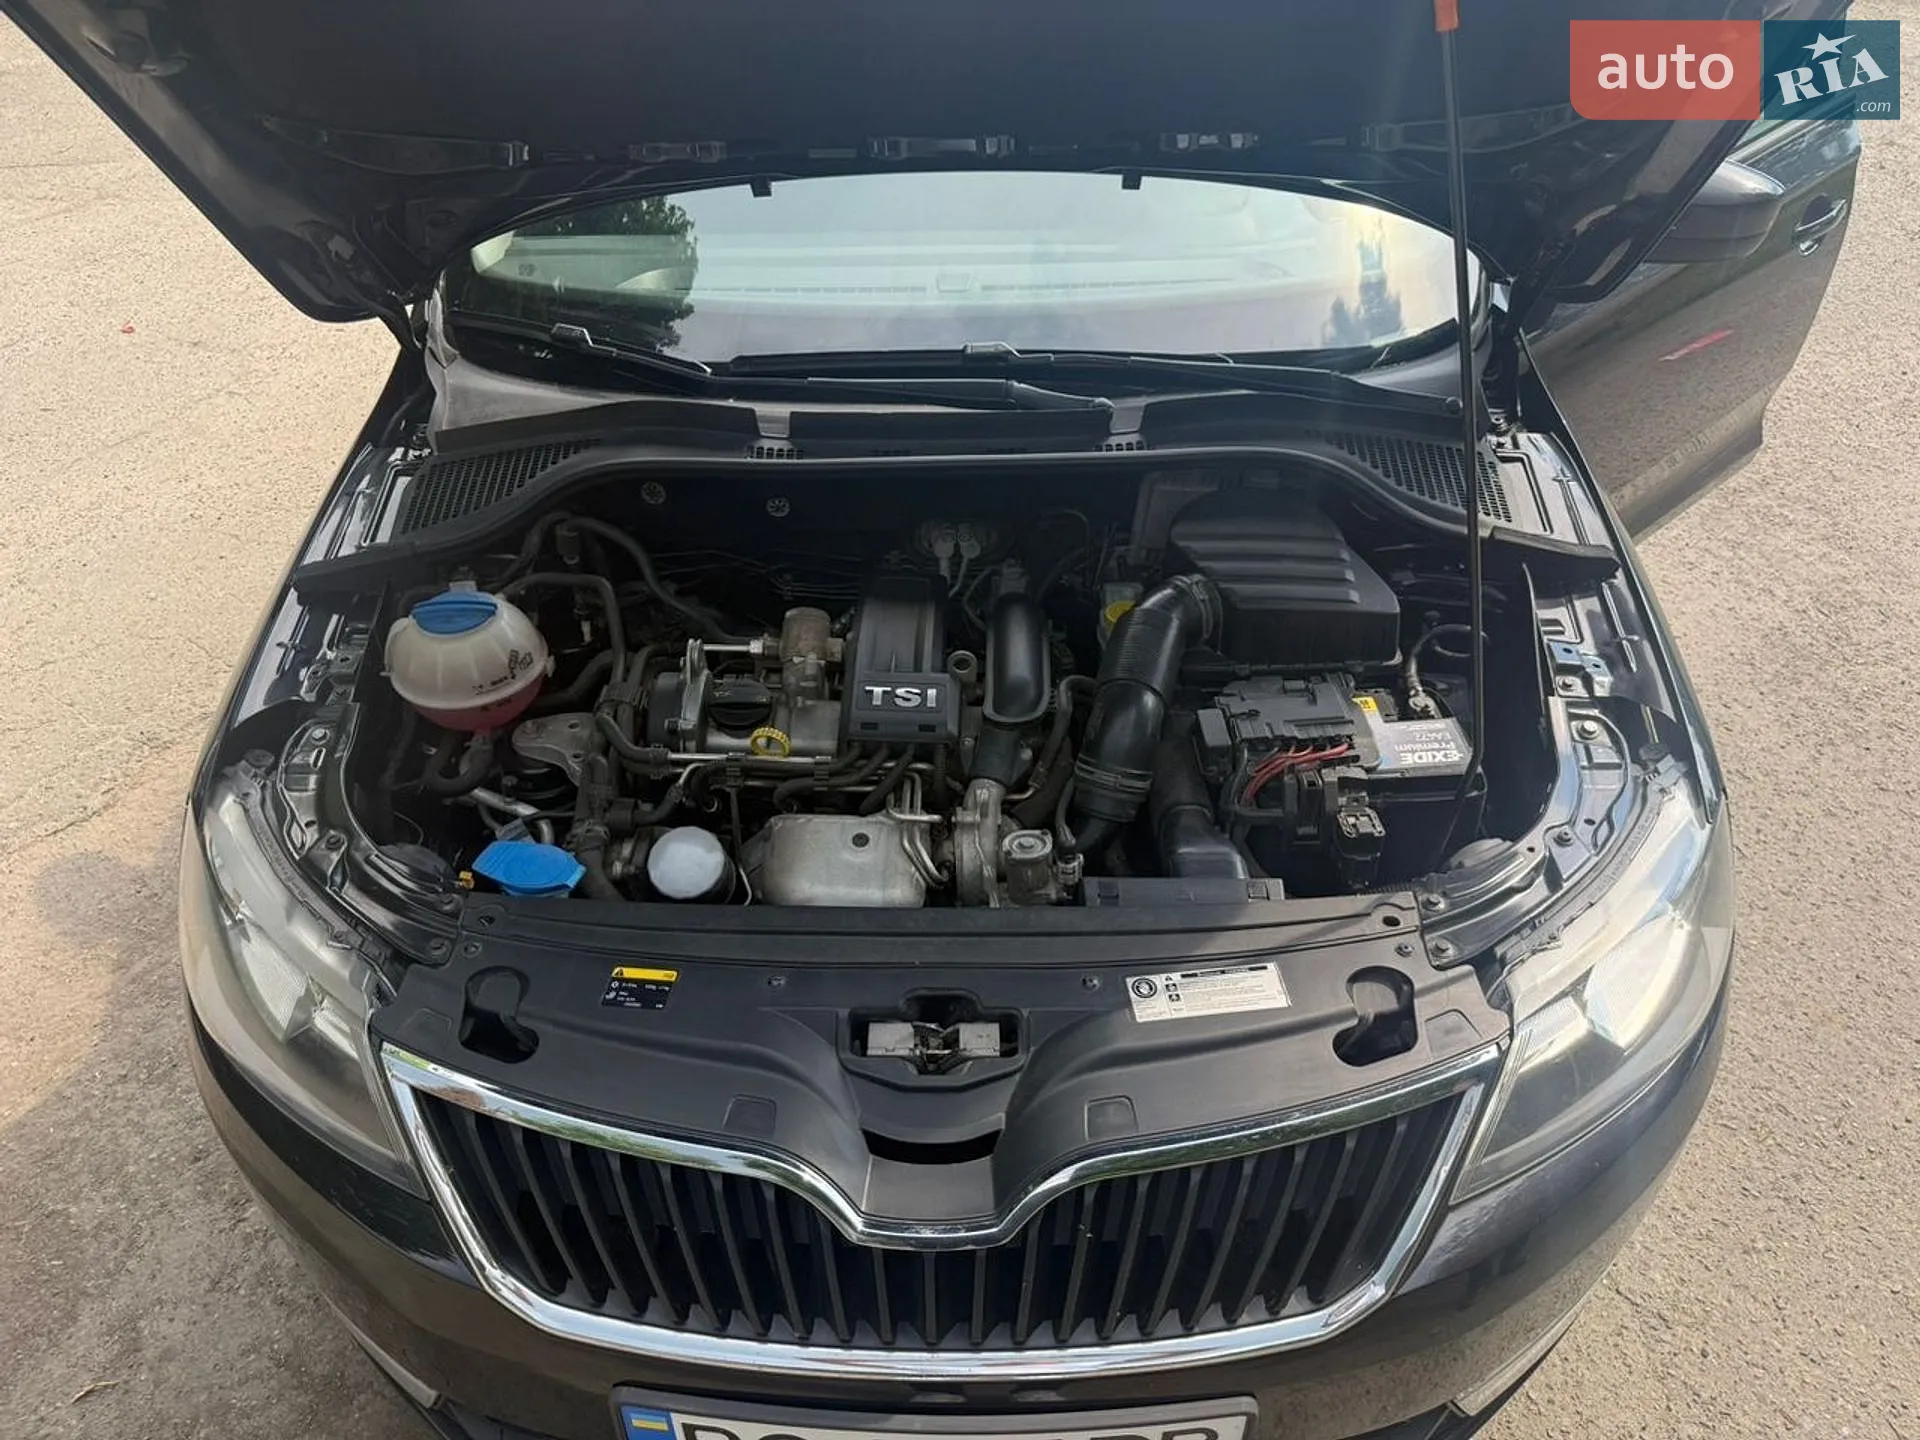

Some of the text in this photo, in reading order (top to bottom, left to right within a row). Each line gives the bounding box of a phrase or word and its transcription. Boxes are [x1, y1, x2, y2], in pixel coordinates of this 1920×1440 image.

[864, 685, 937, 708] TSI
[1394, 741, 1456, 752] Premium
[1401, 751, 1461, 765] EXIDE
